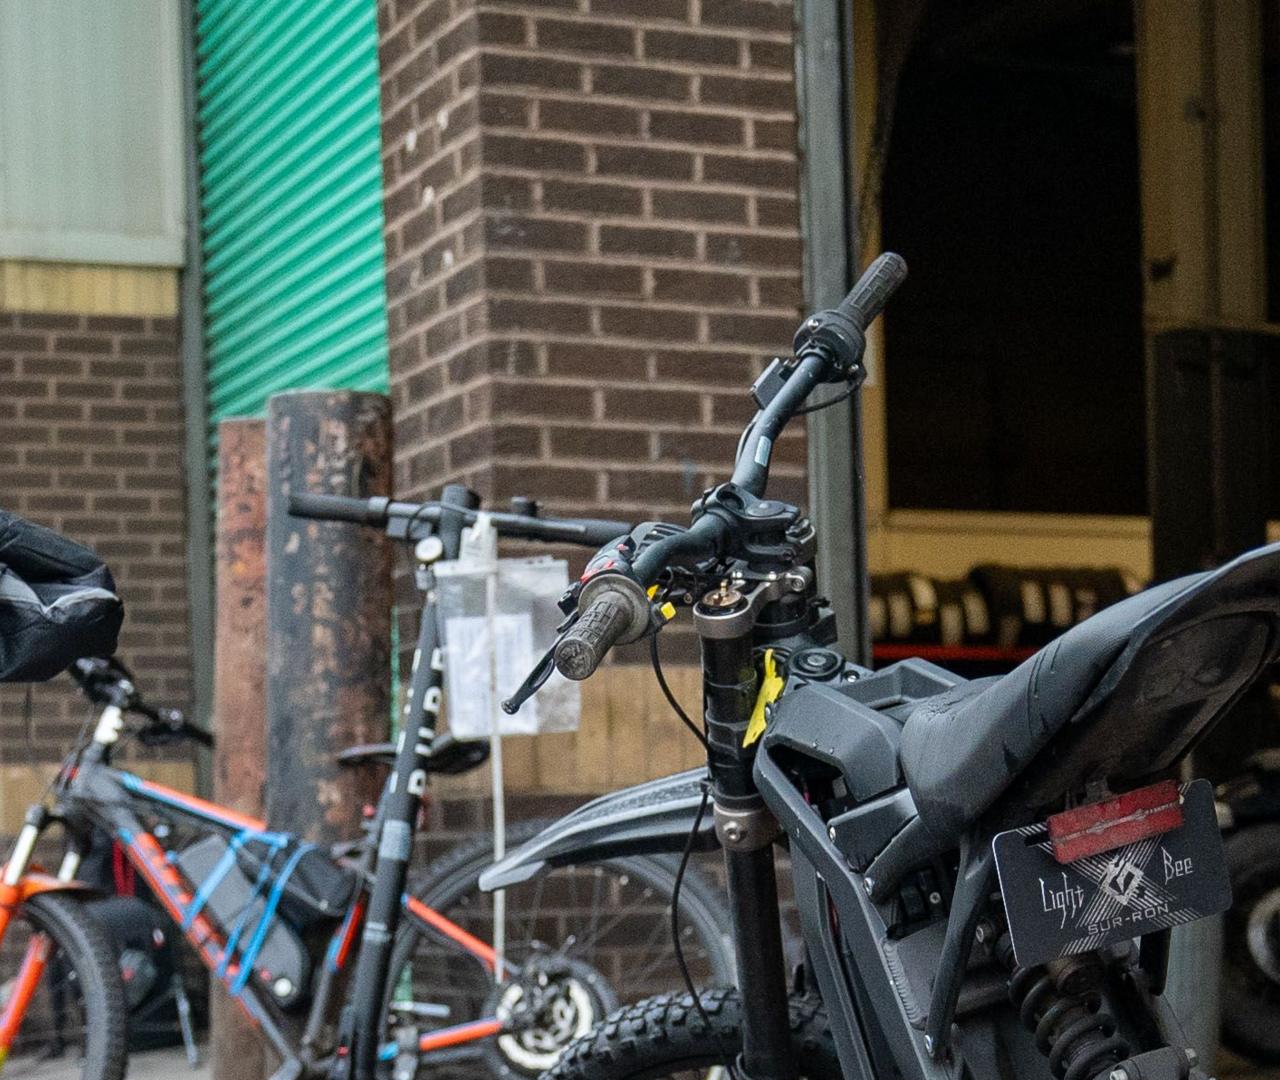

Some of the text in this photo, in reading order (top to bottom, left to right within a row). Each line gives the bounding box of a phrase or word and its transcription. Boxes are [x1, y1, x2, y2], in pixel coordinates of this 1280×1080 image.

[1038, 847, 1194, 929] Light Bee
[1086, 903, 1170, 936] SUR-RON
